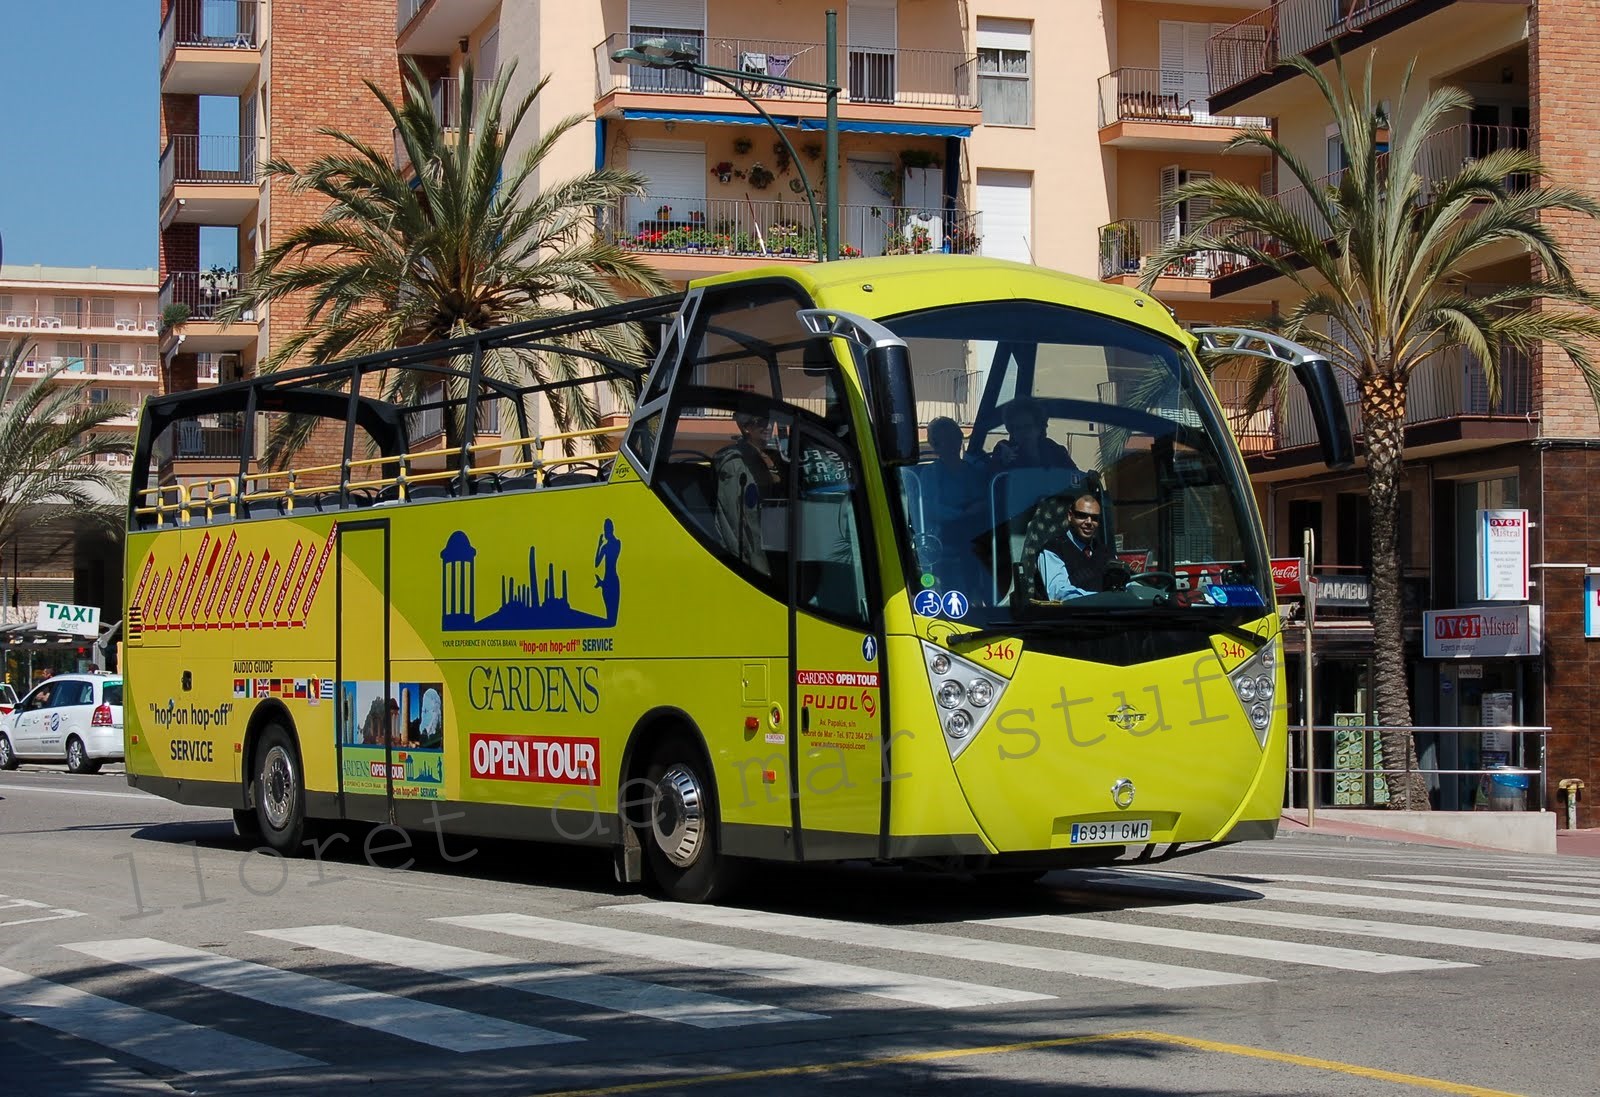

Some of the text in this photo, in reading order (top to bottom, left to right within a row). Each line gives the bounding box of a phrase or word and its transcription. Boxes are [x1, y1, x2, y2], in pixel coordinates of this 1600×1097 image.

[47, 604, 93, 623] TAXI
[1436, 615, 1520, 637] over Mistral
[582, 638, 613, 651] SERVICE
[982, 643, 1014, 661] 346
[1221, 642, 1245, 658] 346
[233, 661, 273, 673] AUDIO GUIDE
[798, 672, 877, 686] GARDENS OPEN TOUR
[468, 665, 600, 714] GARDENS
[803, 694, 858, 710] PUJOL
[170, 740, 213, 762] SERVICE
[473, 739, 597, 780] OPEN TOUR
[343, 760, 369, 777] ARDENS
[391, 765, 404, 779] OUR
[421, 787, 438, 798] SERVICE
[1080, 824, 1115, 840] 6931
[1121, 822, 1149, 839] GMD
